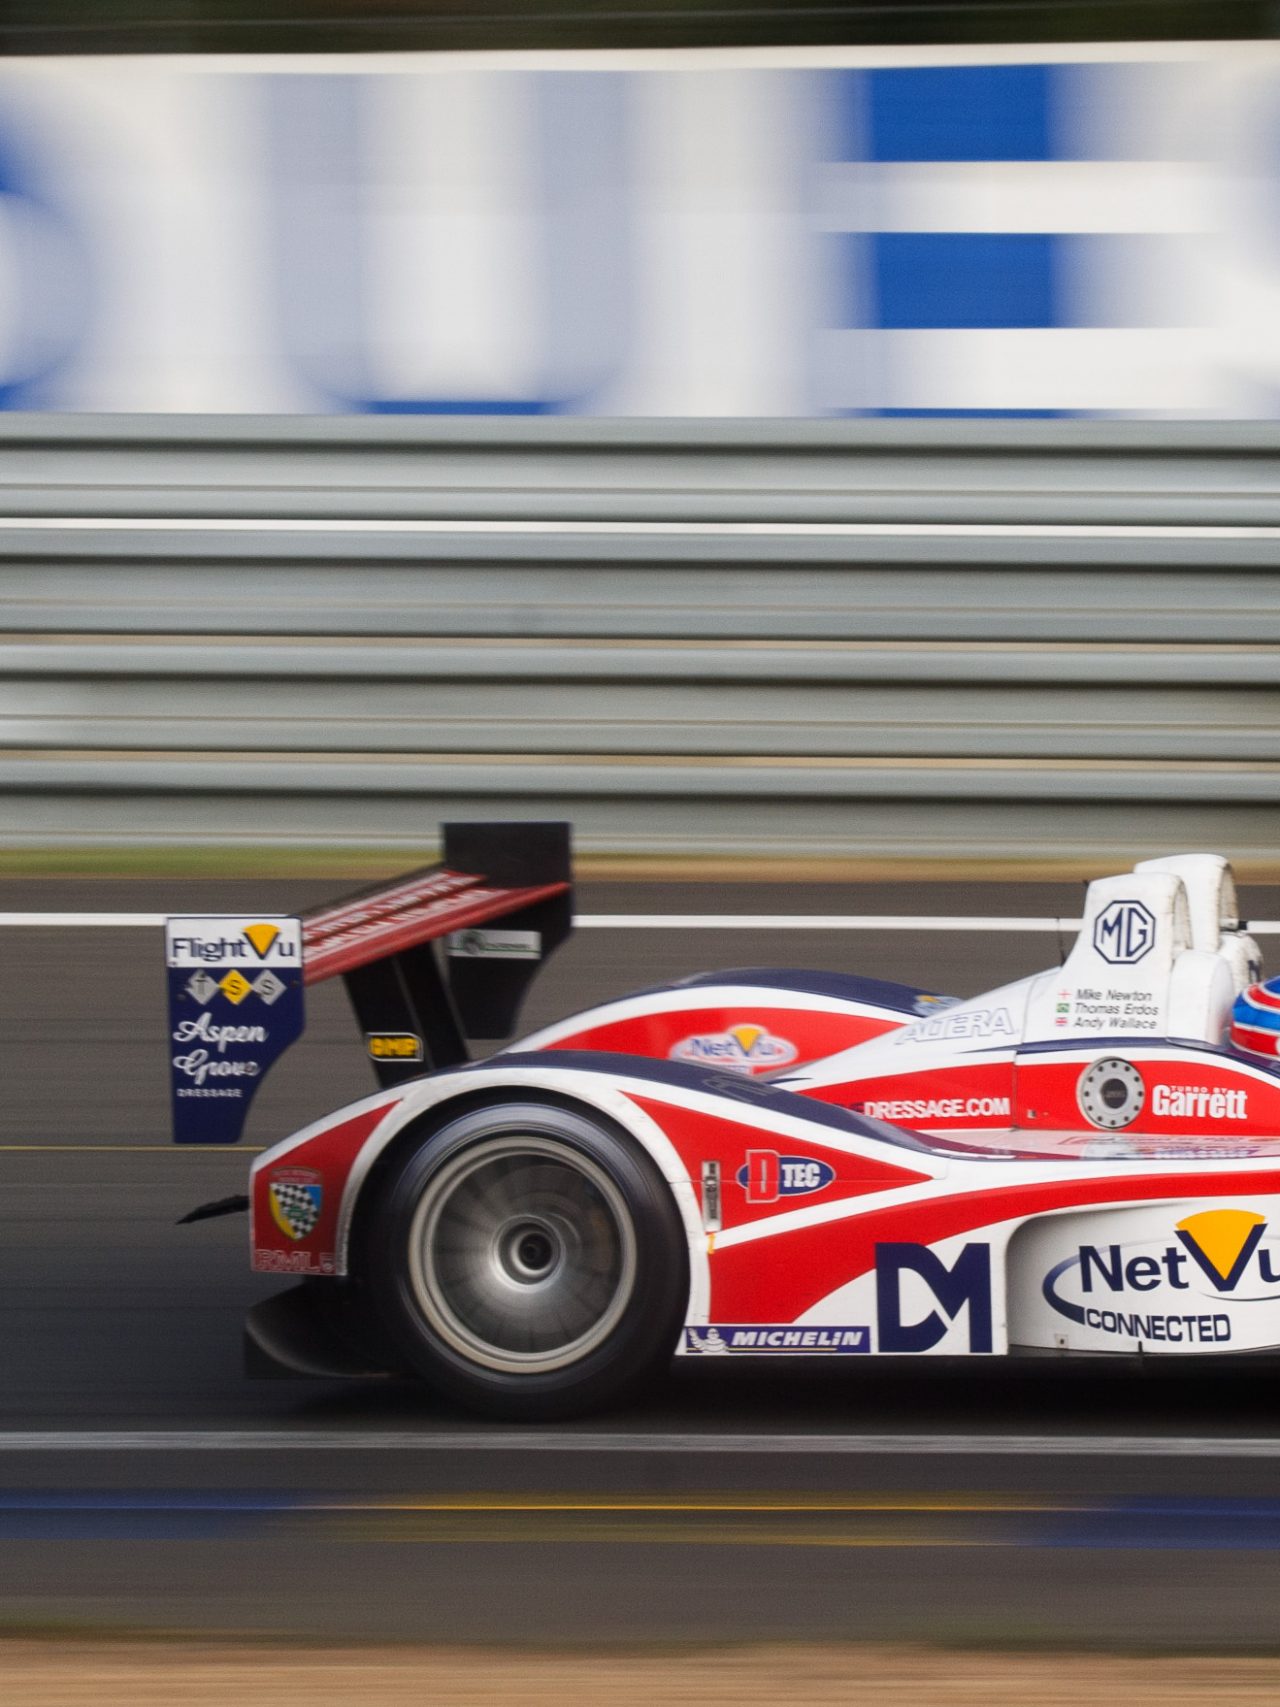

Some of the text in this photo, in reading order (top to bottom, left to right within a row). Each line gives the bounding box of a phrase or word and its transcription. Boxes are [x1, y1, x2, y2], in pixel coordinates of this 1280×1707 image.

[172, 930, 295, 962] FlightVu
[1100, 906, 1149, 959] MG
[1074, 1002, 1159, 1017] Thomas Erdos
[1076, 988, 1152, 1002] Mike Newton
[172, 1011, 269, 1054] Aspen
[1073, 1016, 1158, 1031] Andy Wallace
[172, 1048, 261, 1086] Grove
[176, 1088, 243, 1098] DRESSAGE
[1152, 1084, 1248, 1120] Garrett
[731, 1331, 863, 1346] MICHELIN
[1084, 1307, 1232, 1343] CONNECTED
